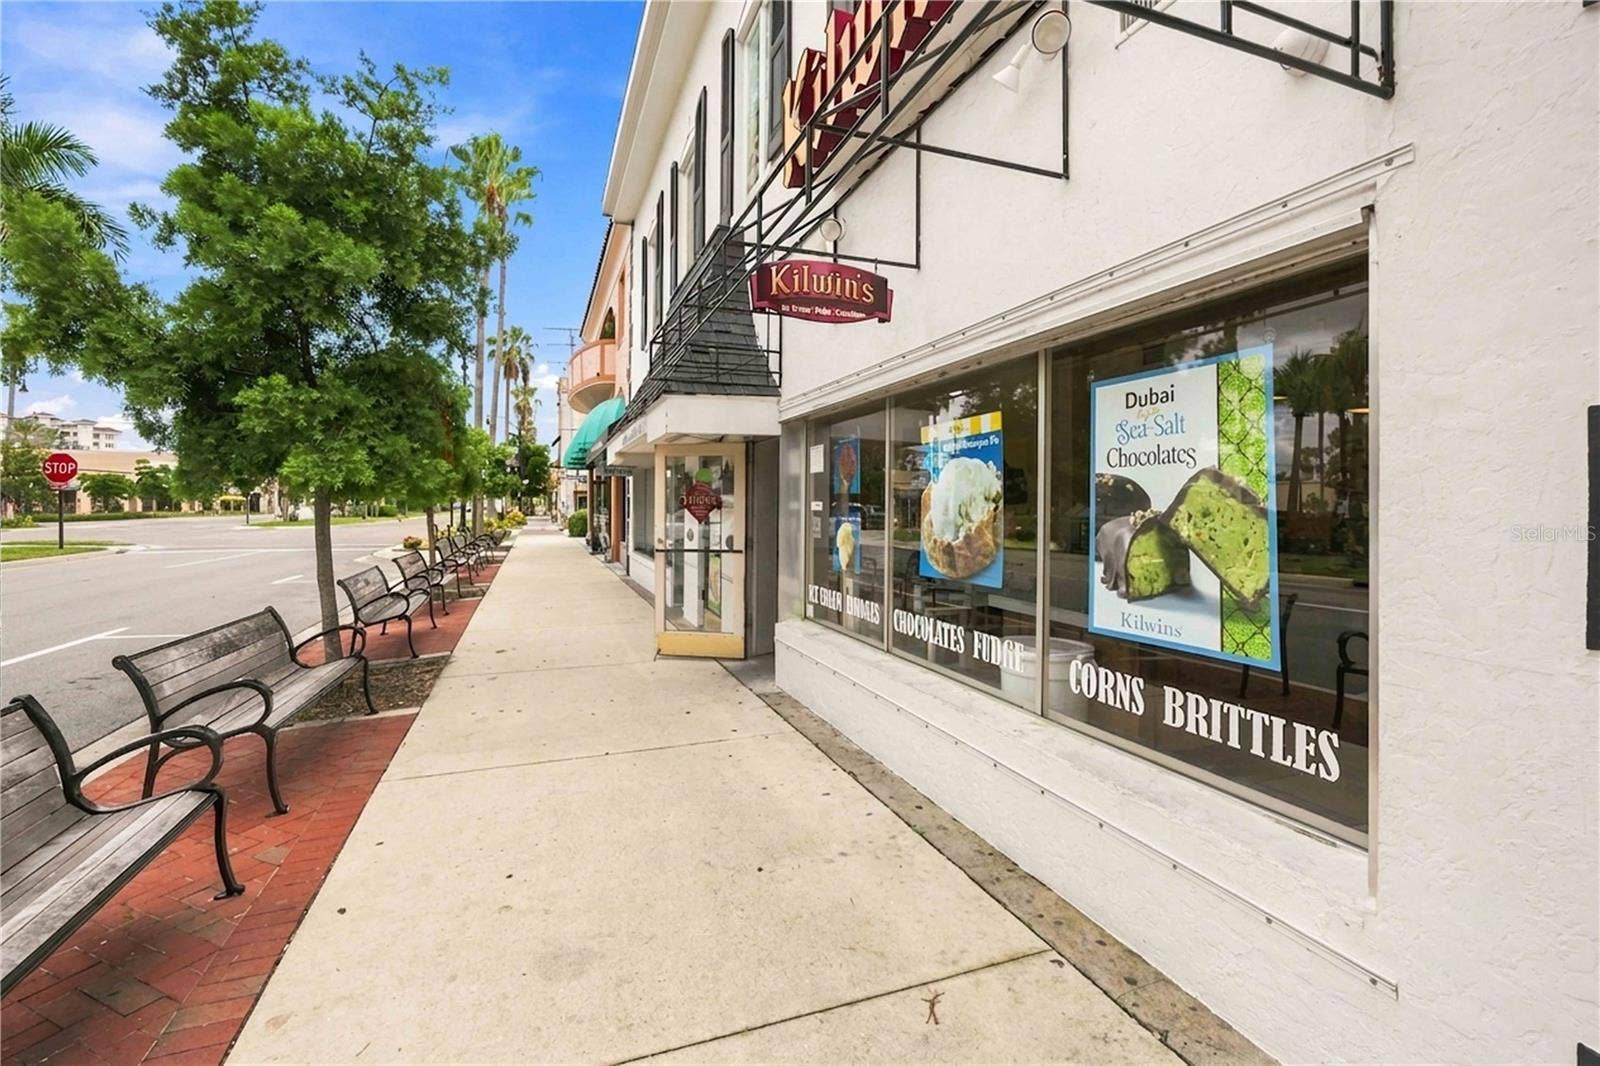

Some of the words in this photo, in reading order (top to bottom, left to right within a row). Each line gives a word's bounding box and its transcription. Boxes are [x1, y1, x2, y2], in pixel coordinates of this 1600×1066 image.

[769, 264, 875, 303] Kilwin's
[1125, 383, 1175, 409] Dubai
[44, 461, 76, 474] STOP
[1106, 443, 1197, 469] Chocolates
[893, 608, 965, 654] CHOCOLATES
[1120, 611, 1183, 638] Kilwins
[1068, 658, 1145, 716] CORNS
[1162, 685, 1341, 783] BRITTLES
